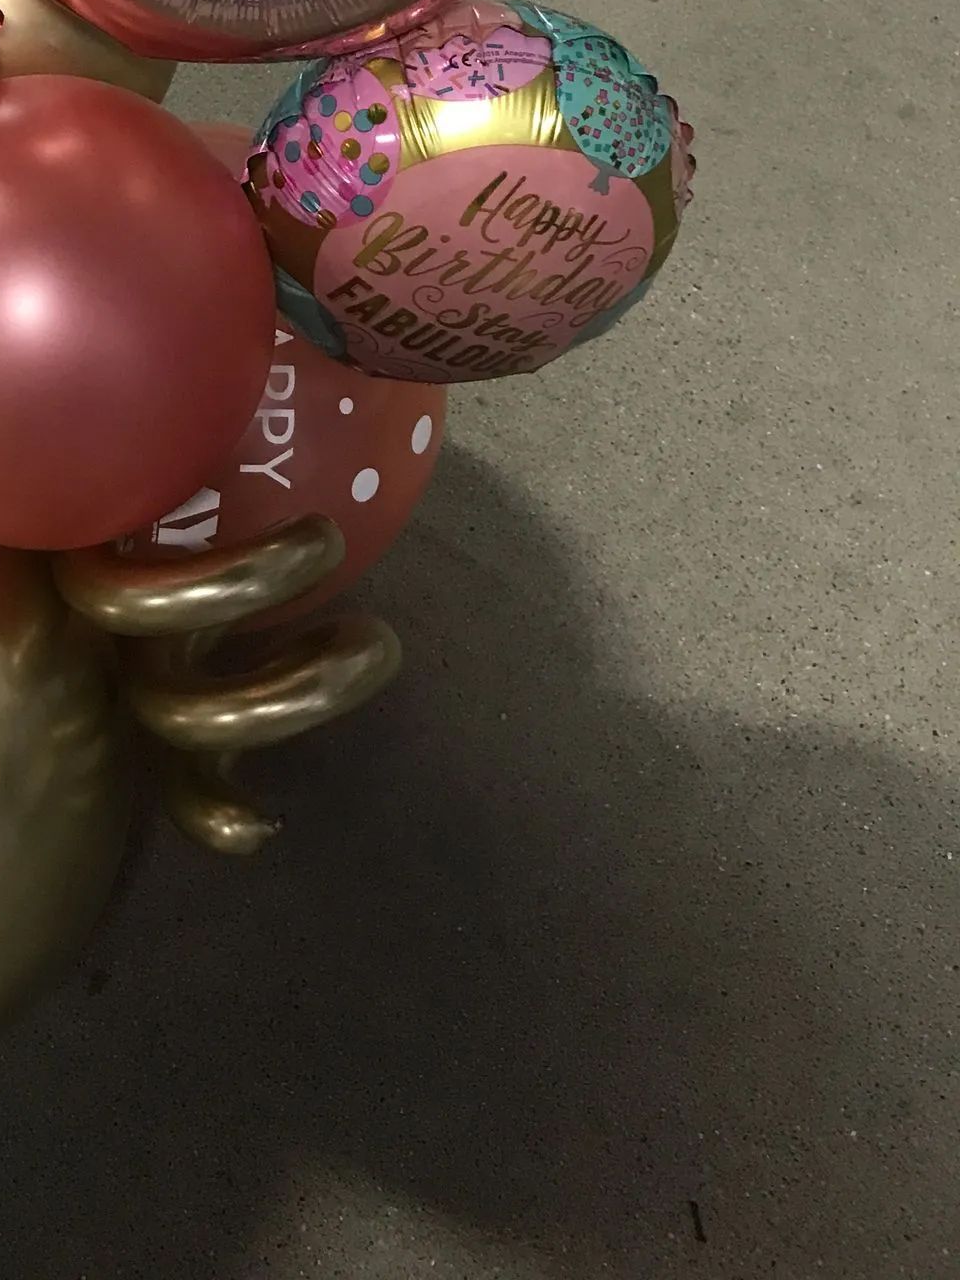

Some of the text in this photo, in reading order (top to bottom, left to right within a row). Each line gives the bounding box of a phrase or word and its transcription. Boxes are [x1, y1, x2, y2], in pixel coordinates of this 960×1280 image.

[503, 49, 537, 59] Anagram
[459, 171, 630, 262] Happy
[353, 211, 624, 328] Birthday
[327, 276, 538, 372] FABULOUS
[435, 302, 558, 352] Stay
